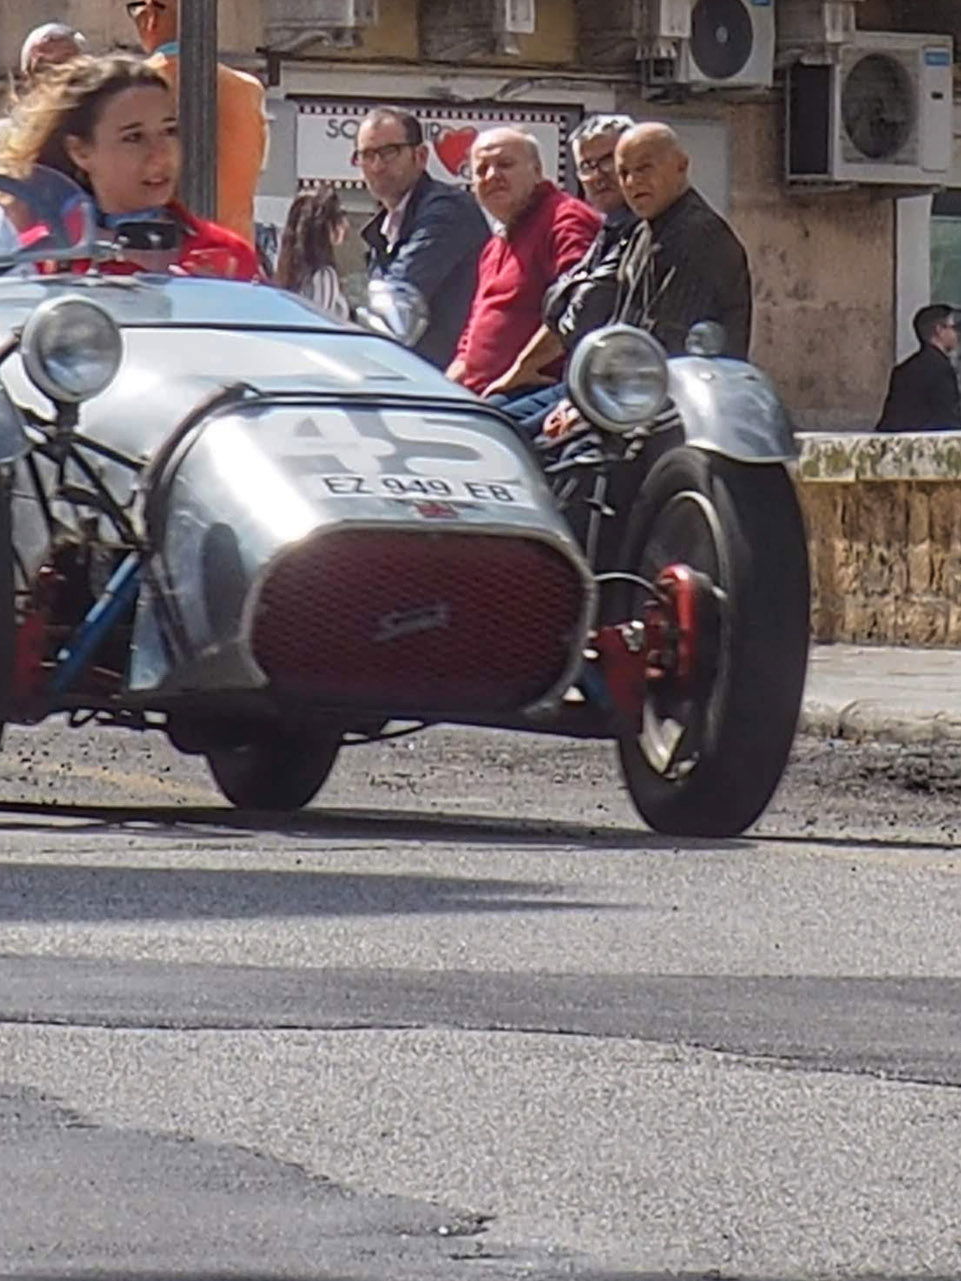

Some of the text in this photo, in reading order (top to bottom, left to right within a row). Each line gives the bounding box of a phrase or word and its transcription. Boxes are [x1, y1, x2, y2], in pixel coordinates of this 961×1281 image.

[323, 476, 515, 502] EZ 949 EB
